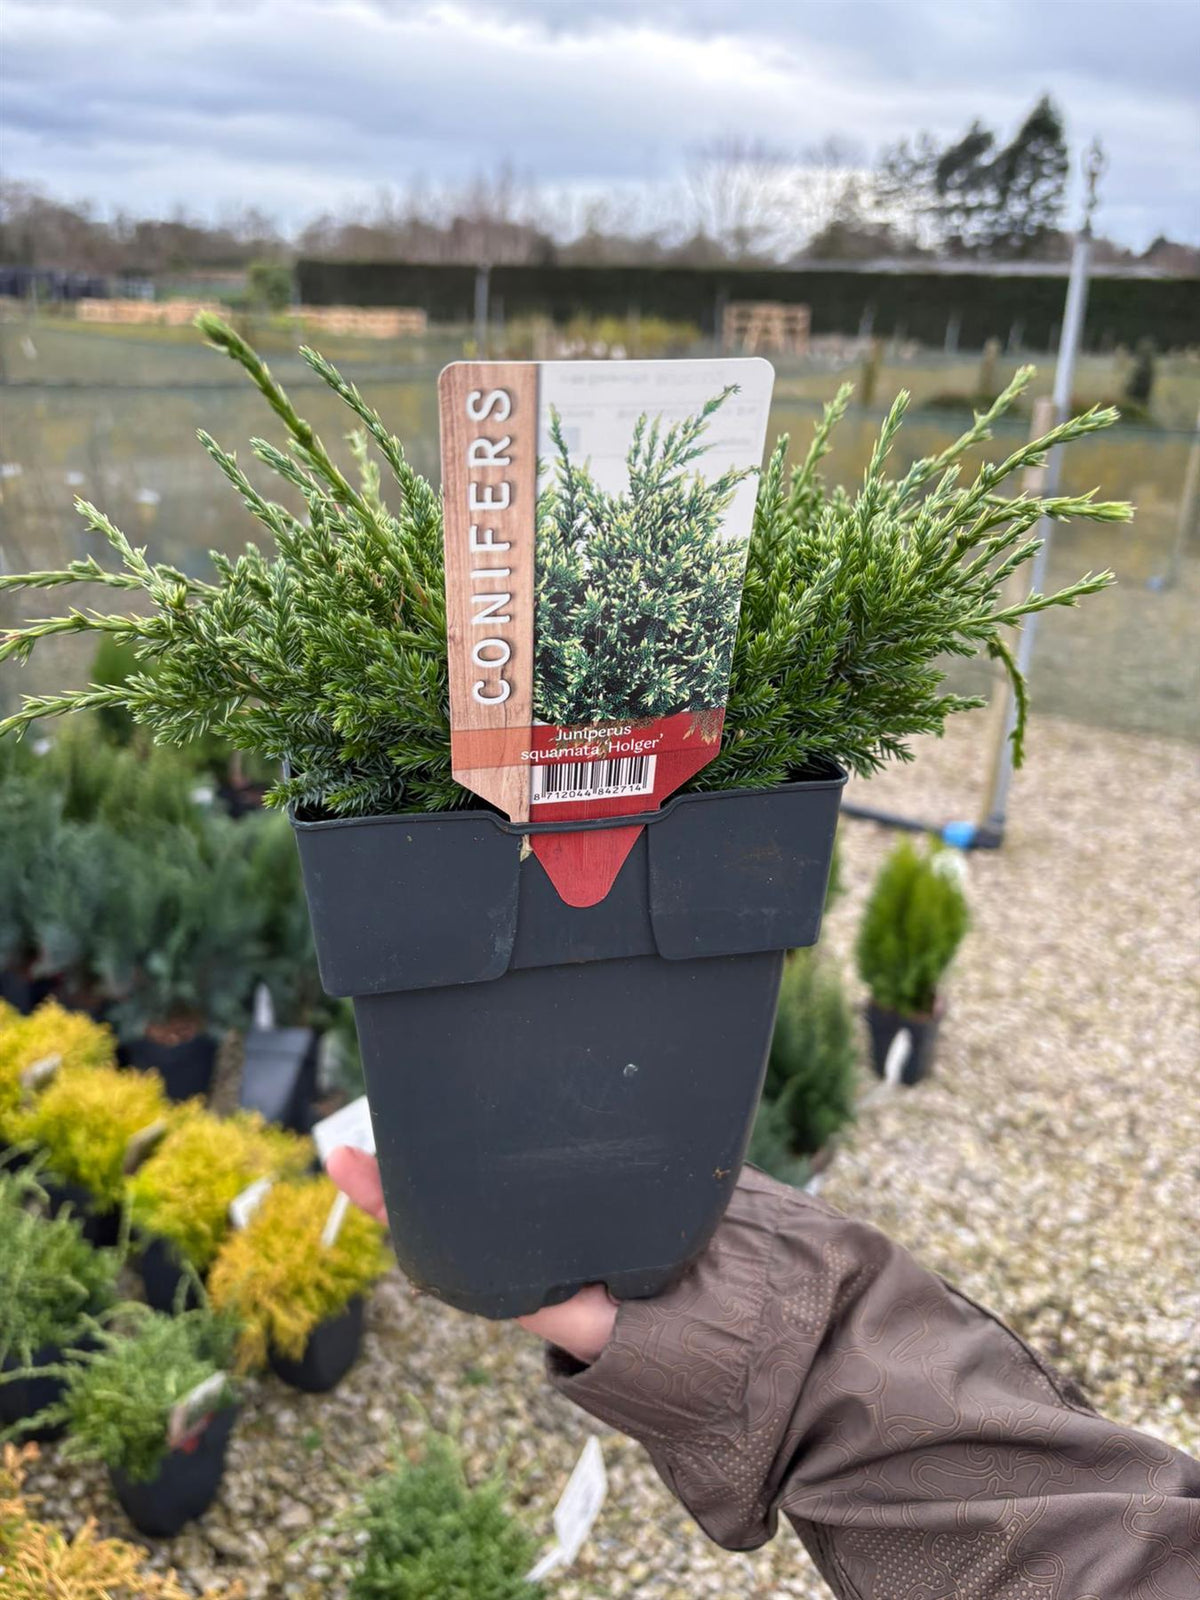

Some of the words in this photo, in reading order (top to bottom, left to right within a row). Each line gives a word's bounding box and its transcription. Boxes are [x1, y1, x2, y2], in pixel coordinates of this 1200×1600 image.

[466, 389, 512, 706] CONIFERS
[555, 725, 632, 743] Juniperus
[520, 746, 600, 762] squamata
